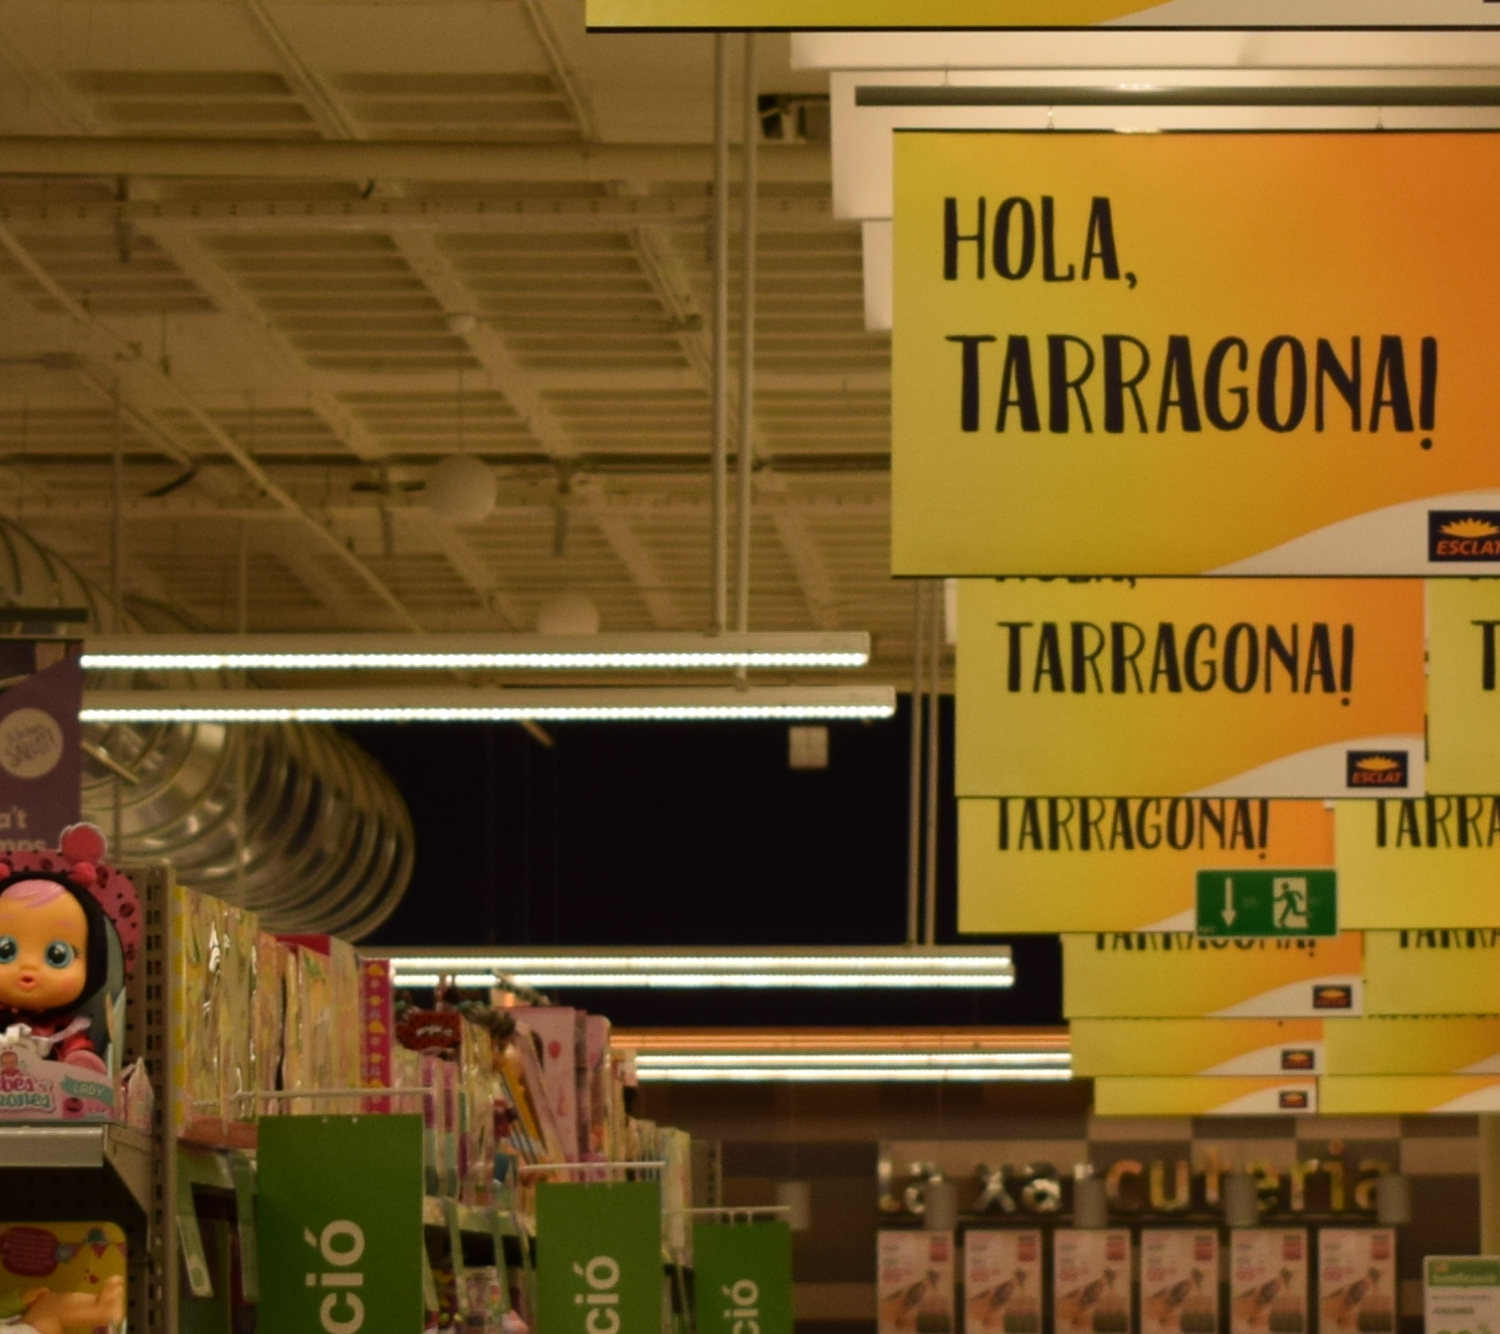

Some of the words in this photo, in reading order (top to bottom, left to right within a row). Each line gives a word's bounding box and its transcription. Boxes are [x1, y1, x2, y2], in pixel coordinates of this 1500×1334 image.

[943, 195, 1137, 289] HOLA,
[945, 334, 1439, 451] TARRAGONA!
[997, 621, 1355, 707] TARRAGONA!
[998, 798, 1270, 860] TARRAGONA!
